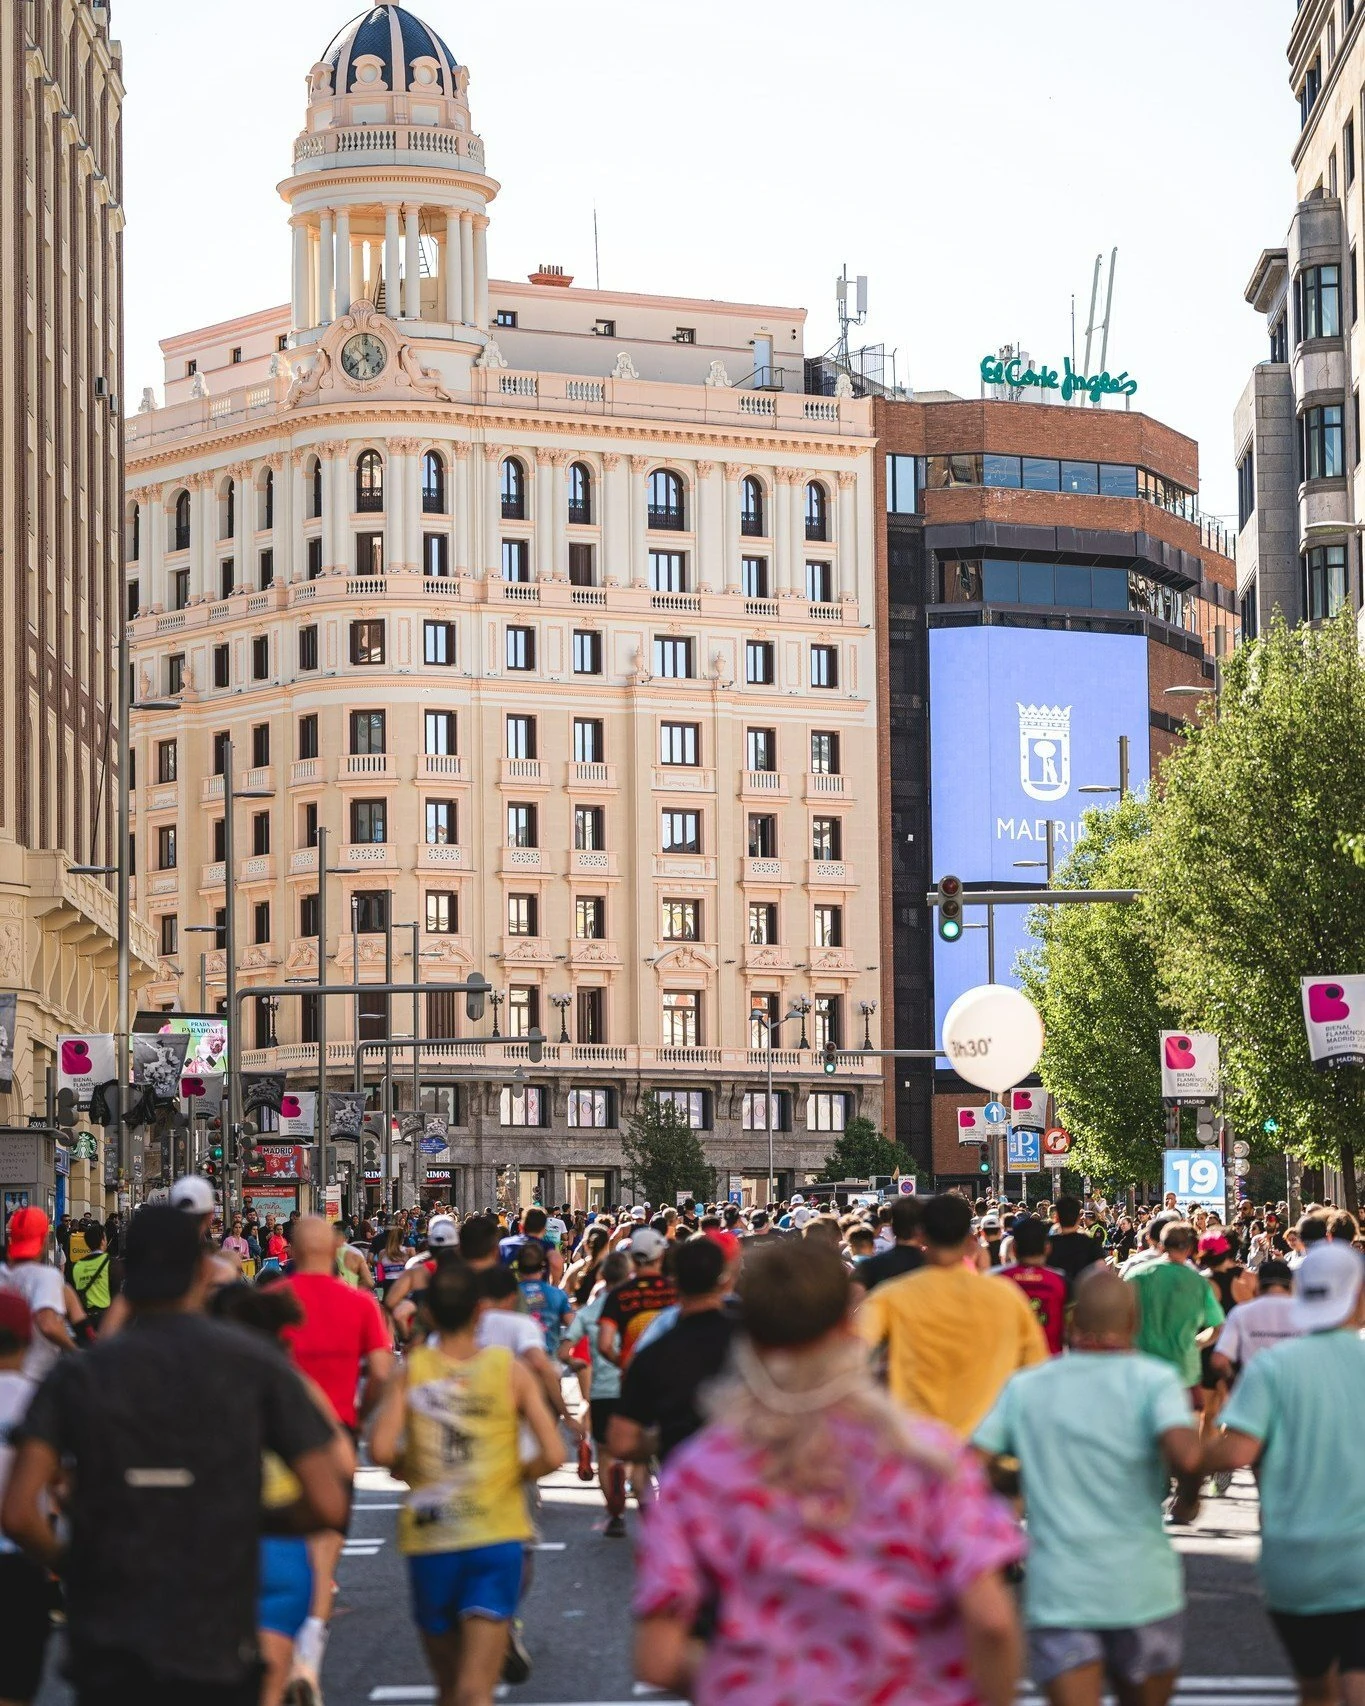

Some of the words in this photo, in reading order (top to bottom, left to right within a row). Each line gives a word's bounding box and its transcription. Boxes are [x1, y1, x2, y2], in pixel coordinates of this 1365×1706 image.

[980, 355, 1004, 384] El
[1004, 359, 1059, 389] Corte
[1061, 356, 1138, 402] Inglés
[1325, 1029, 1365, 1037] FLAMENCO
[1326, 1036, 1355, 1044] MADRID
[1337, 1055, 1364, 1063] MADRID
[1172, 1159, 1218, 1194] 19
